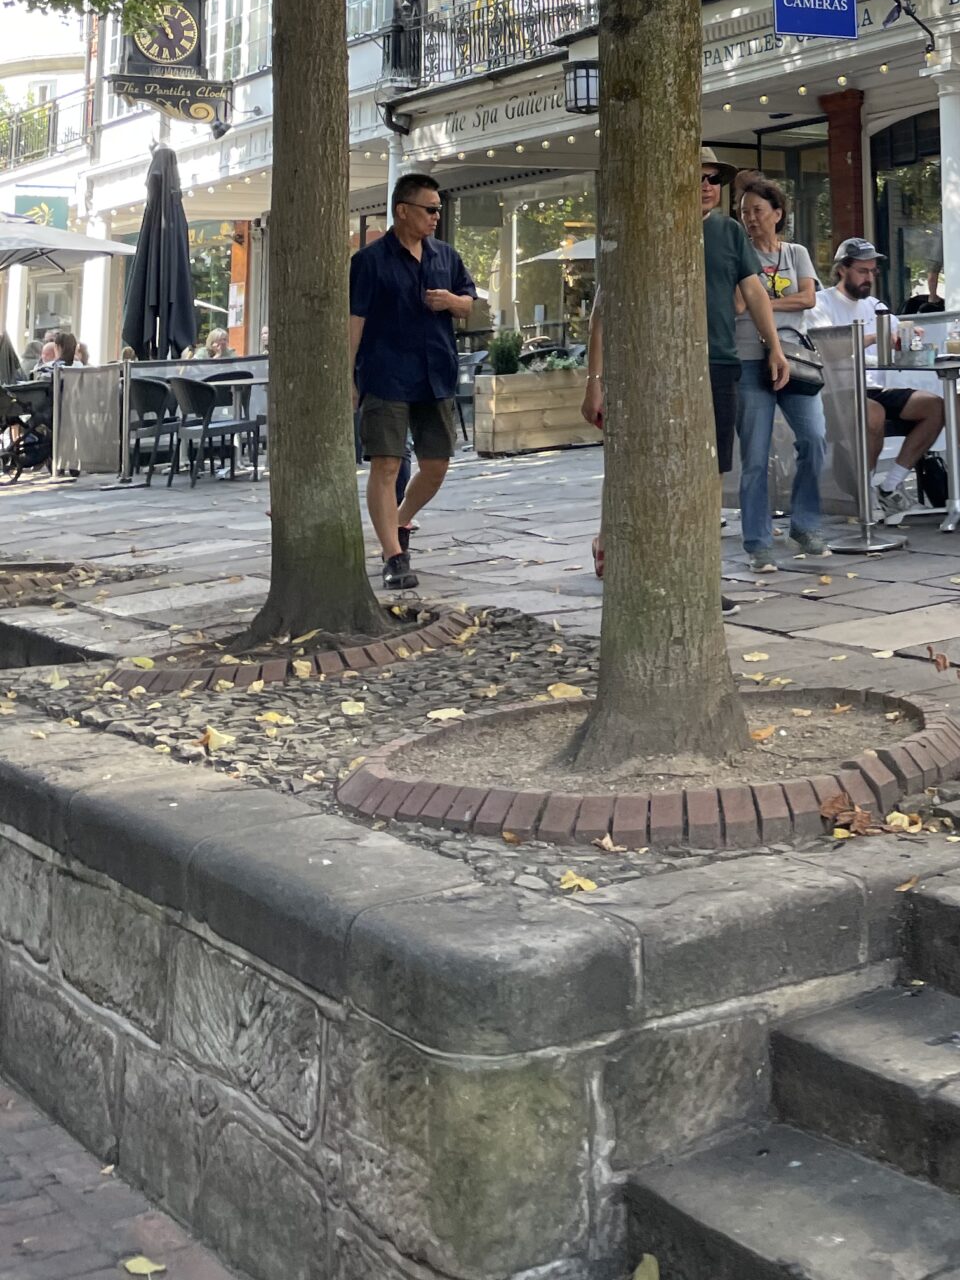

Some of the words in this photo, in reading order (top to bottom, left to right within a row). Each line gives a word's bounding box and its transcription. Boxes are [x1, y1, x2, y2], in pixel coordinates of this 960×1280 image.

[703, 33, 783, 68] PANTILES
[115, 81, 139, 94] The
[144, 83, 191, 97] Pantiles
[195, 86, 227, 99] Clock
[444, 111, 466, 135] The
[472, 104, 498, 131] Spa
